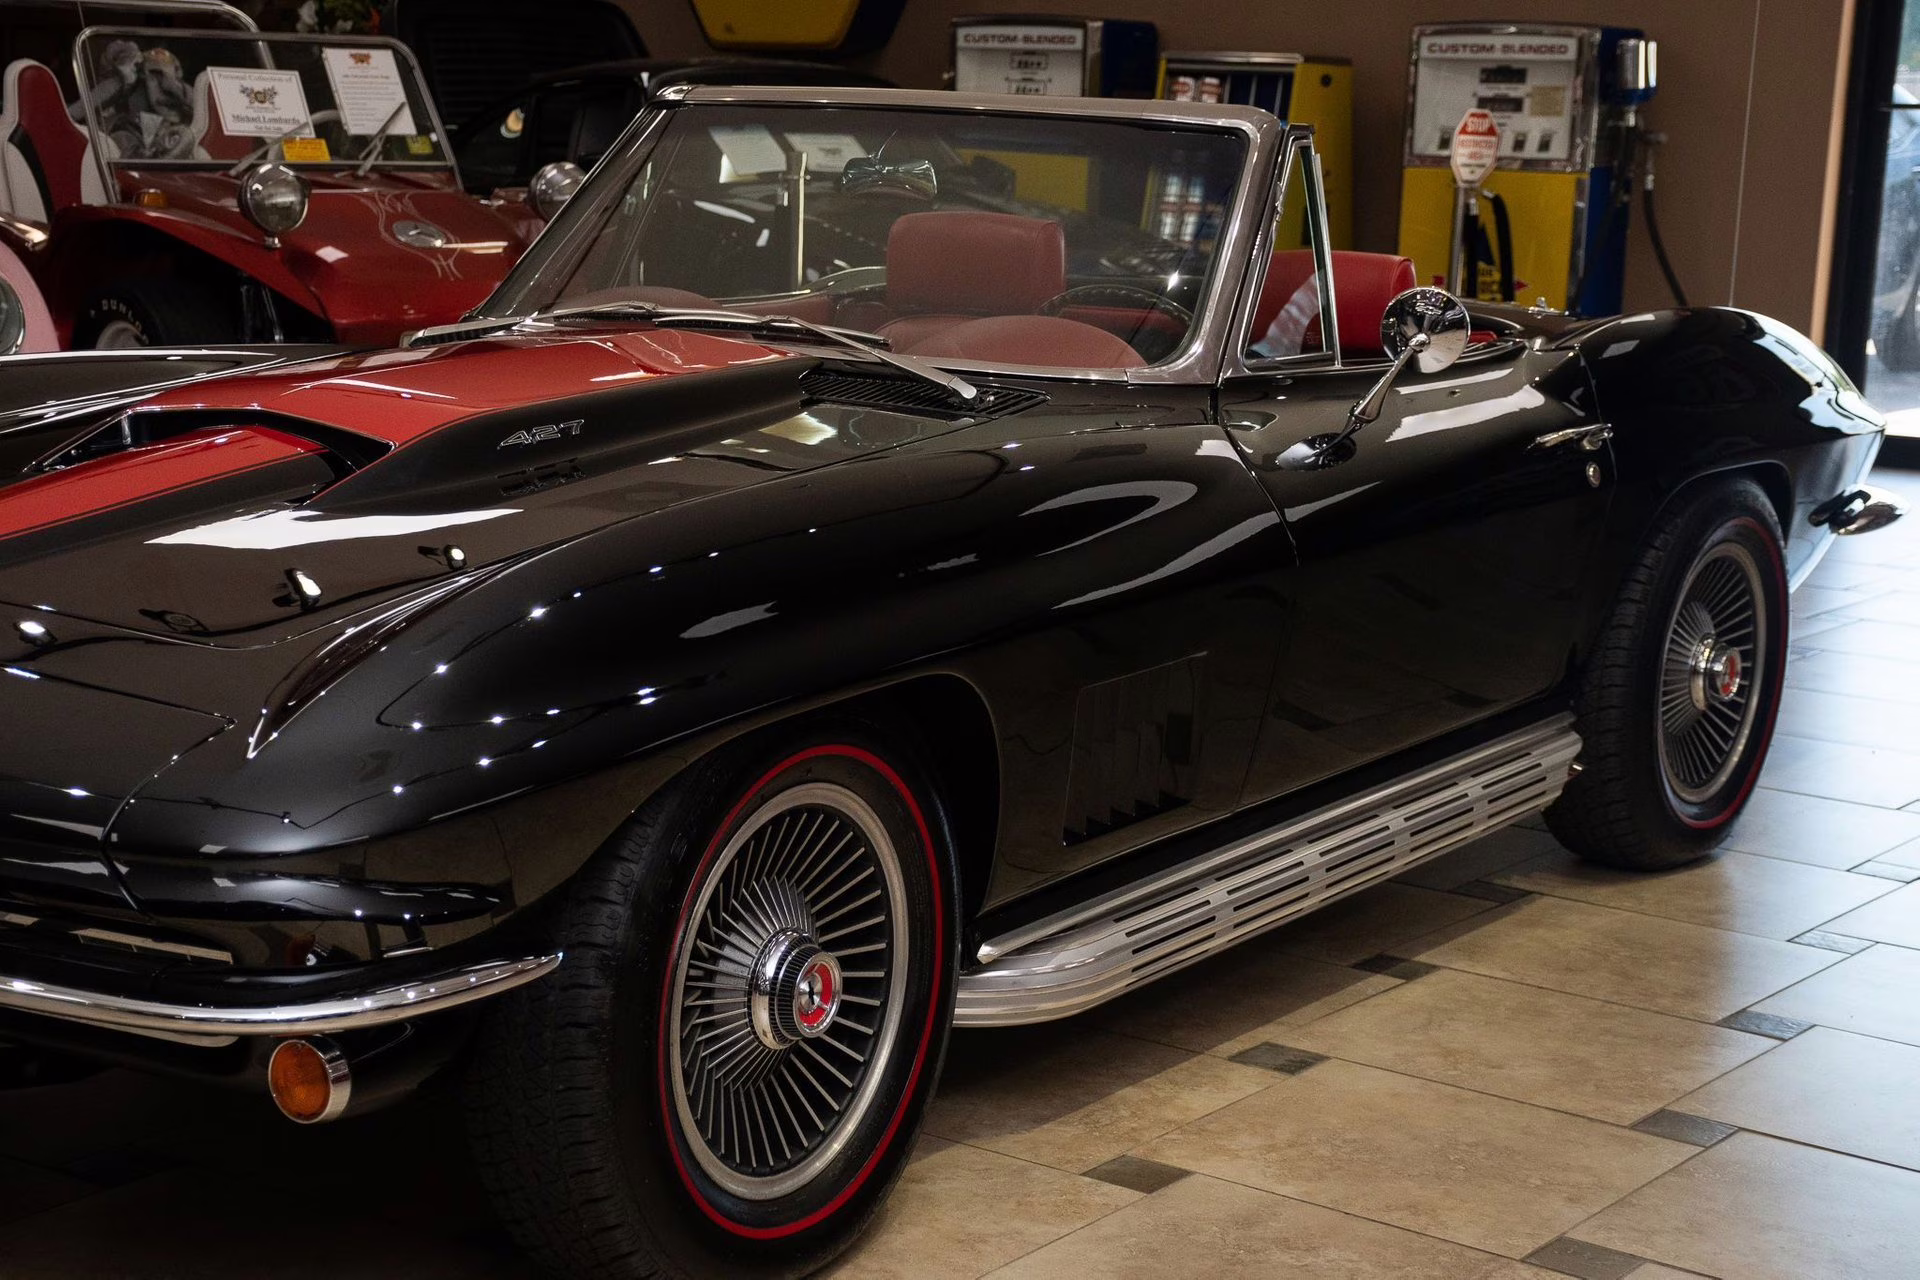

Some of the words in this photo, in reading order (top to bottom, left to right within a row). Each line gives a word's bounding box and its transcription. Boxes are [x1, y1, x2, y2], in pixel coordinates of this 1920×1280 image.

[231, 114, 261, 123] Michael
[1466, 116, 1491, 132] STOP
[499, 419, 584, 446] 427
